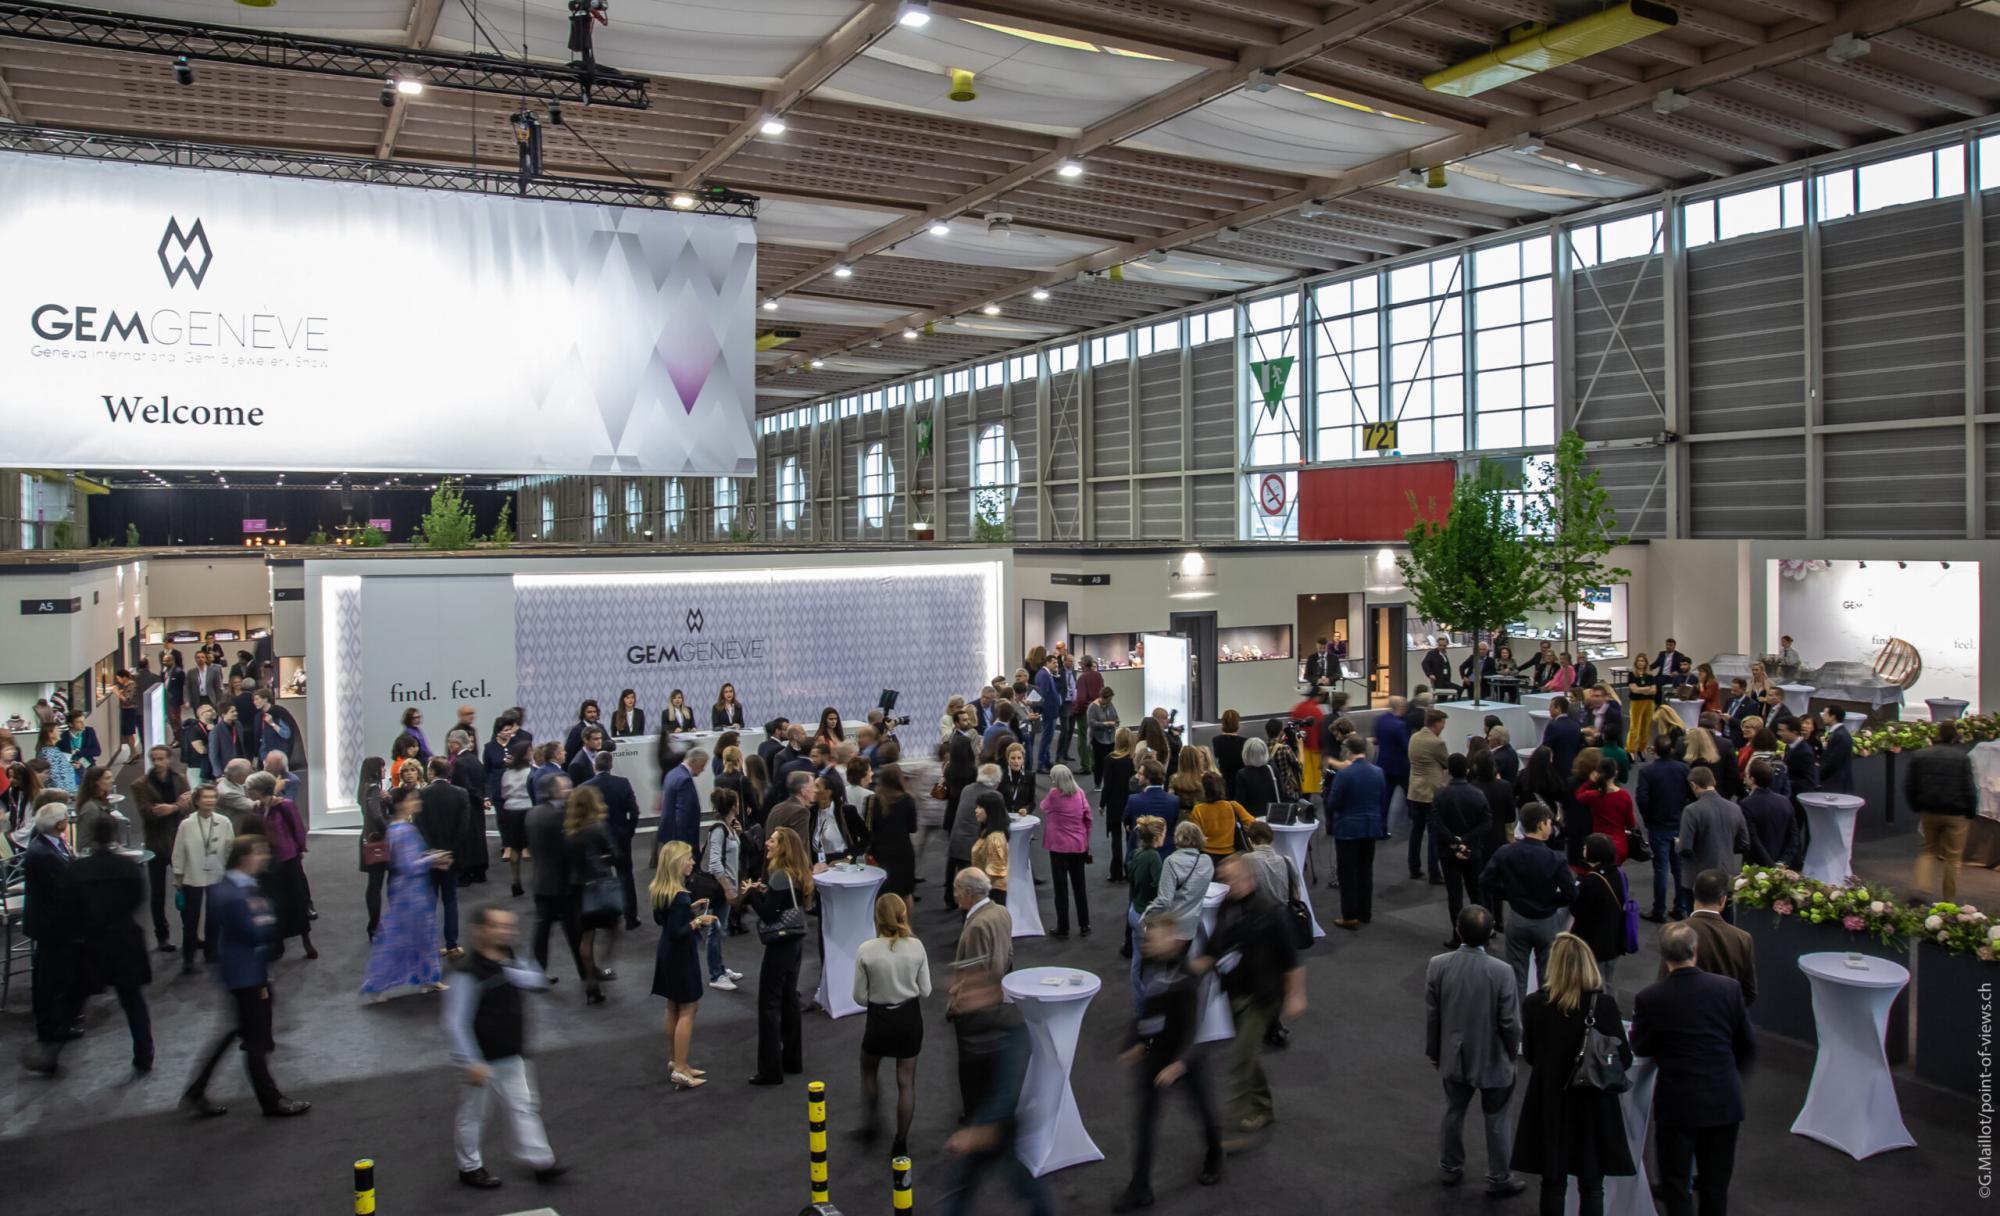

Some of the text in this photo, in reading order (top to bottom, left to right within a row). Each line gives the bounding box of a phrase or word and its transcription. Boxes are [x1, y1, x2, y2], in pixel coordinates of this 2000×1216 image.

[31, 303, 328, 351] GEMGENÈVE
[31, 345, 87, 359] Geneva
[92, 347, 177, 363] nternatona
[101, 395, 264, 426] Welcome
[1363, 422, 1398, 450] 721
[38, 602, 54, 612] A5
[627, 635, 764, 664] GEMGENÈVE
[390, 679, 492, 702] find. feel.
